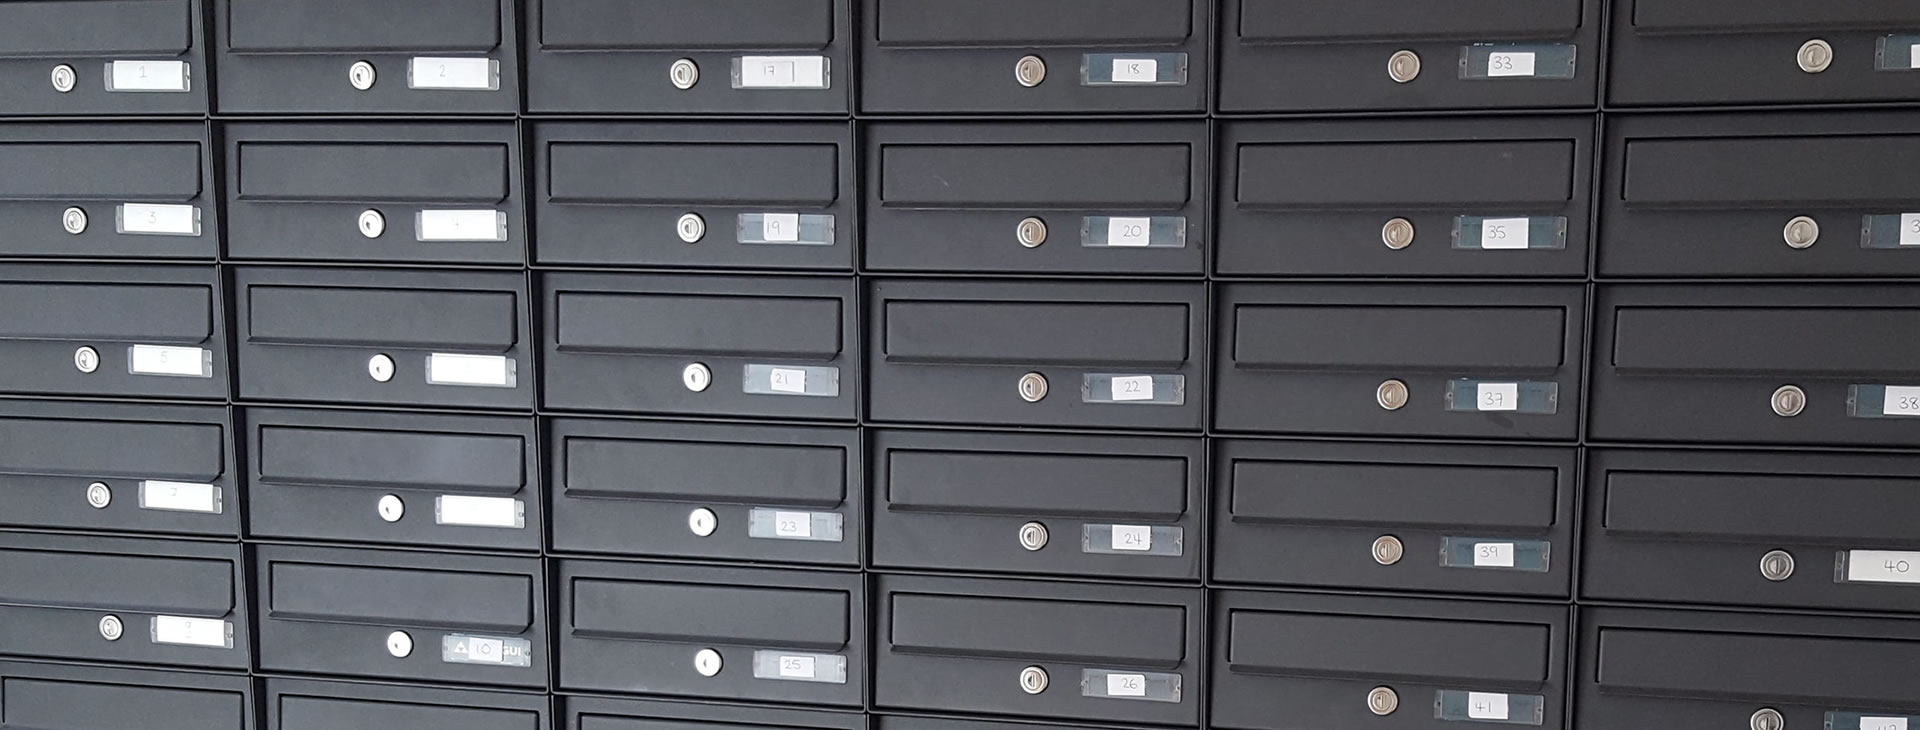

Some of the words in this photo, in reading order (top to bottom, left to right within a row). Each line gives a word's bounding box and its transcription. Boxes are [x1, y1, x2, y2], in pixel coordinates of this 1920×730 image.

[1127, 63, 1140, 75] 18
[1494, 56, 1513, 70] 33
[439, 64, 446, 77] 2
[147, 211, 157, 224] 3
[766, 220, 780, 236] 19
[1123, 224, 1142, 238] 20
[1488, 225, 1506, 240] 35
[160, 350, 169, 364] 5
[775, 372, 788, 385] 21
[1124, 380, 1141, 393] 22
[1484, 391, 1503, 407] 37
[1899, 396, 1919, 410] 38
[781, 520, 797, 533] 23
[1124, 532, 1142, 545] 24
[1479, 546, 1498, 558] 39
[1884, 560, 1910, 574] 40
[476, 643, 492, 655] 10
[783, 659, 801, 671] 25
[1122, 677, 1138, 690] 26
[1475, 701, 1491, 713] 41
